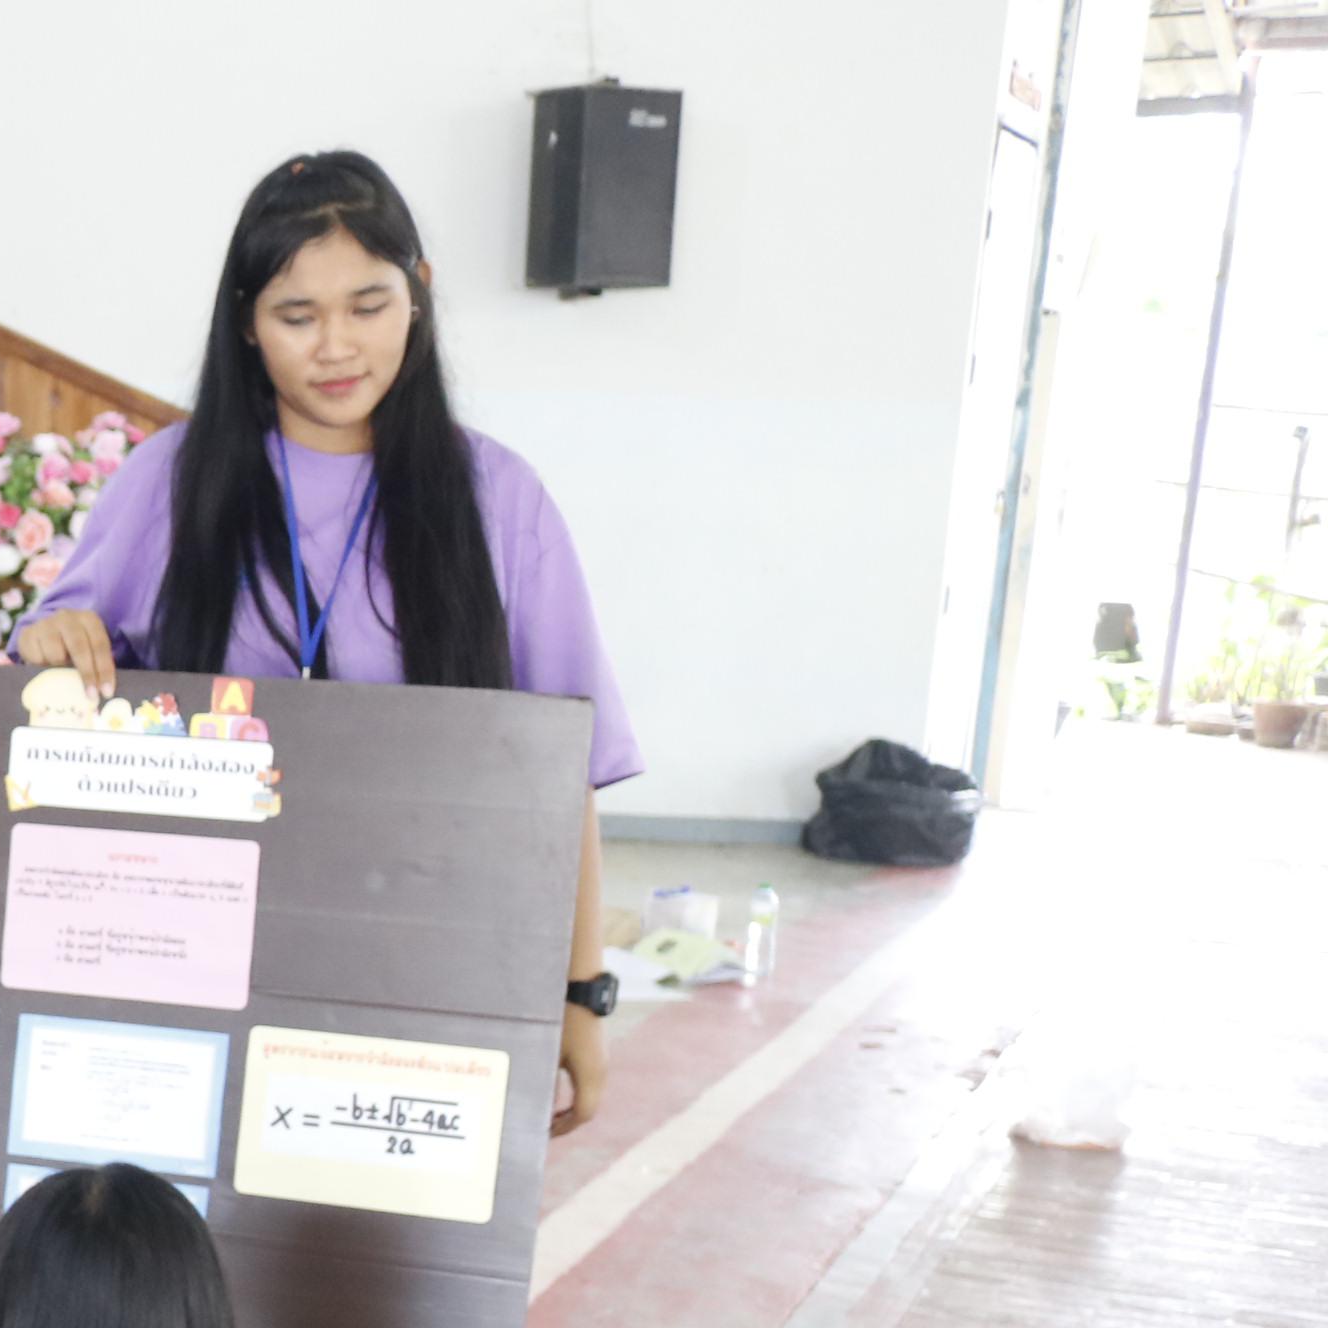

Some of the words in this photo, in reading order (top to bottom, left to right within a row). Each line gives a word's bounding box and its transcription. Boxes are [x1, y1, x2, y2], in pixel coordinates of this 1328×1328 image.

[219, 680, 246, 713] A
[77, 774, 198, 800] ตัวแปรเดียว
[385, 1135, 415, 1155] 2a
